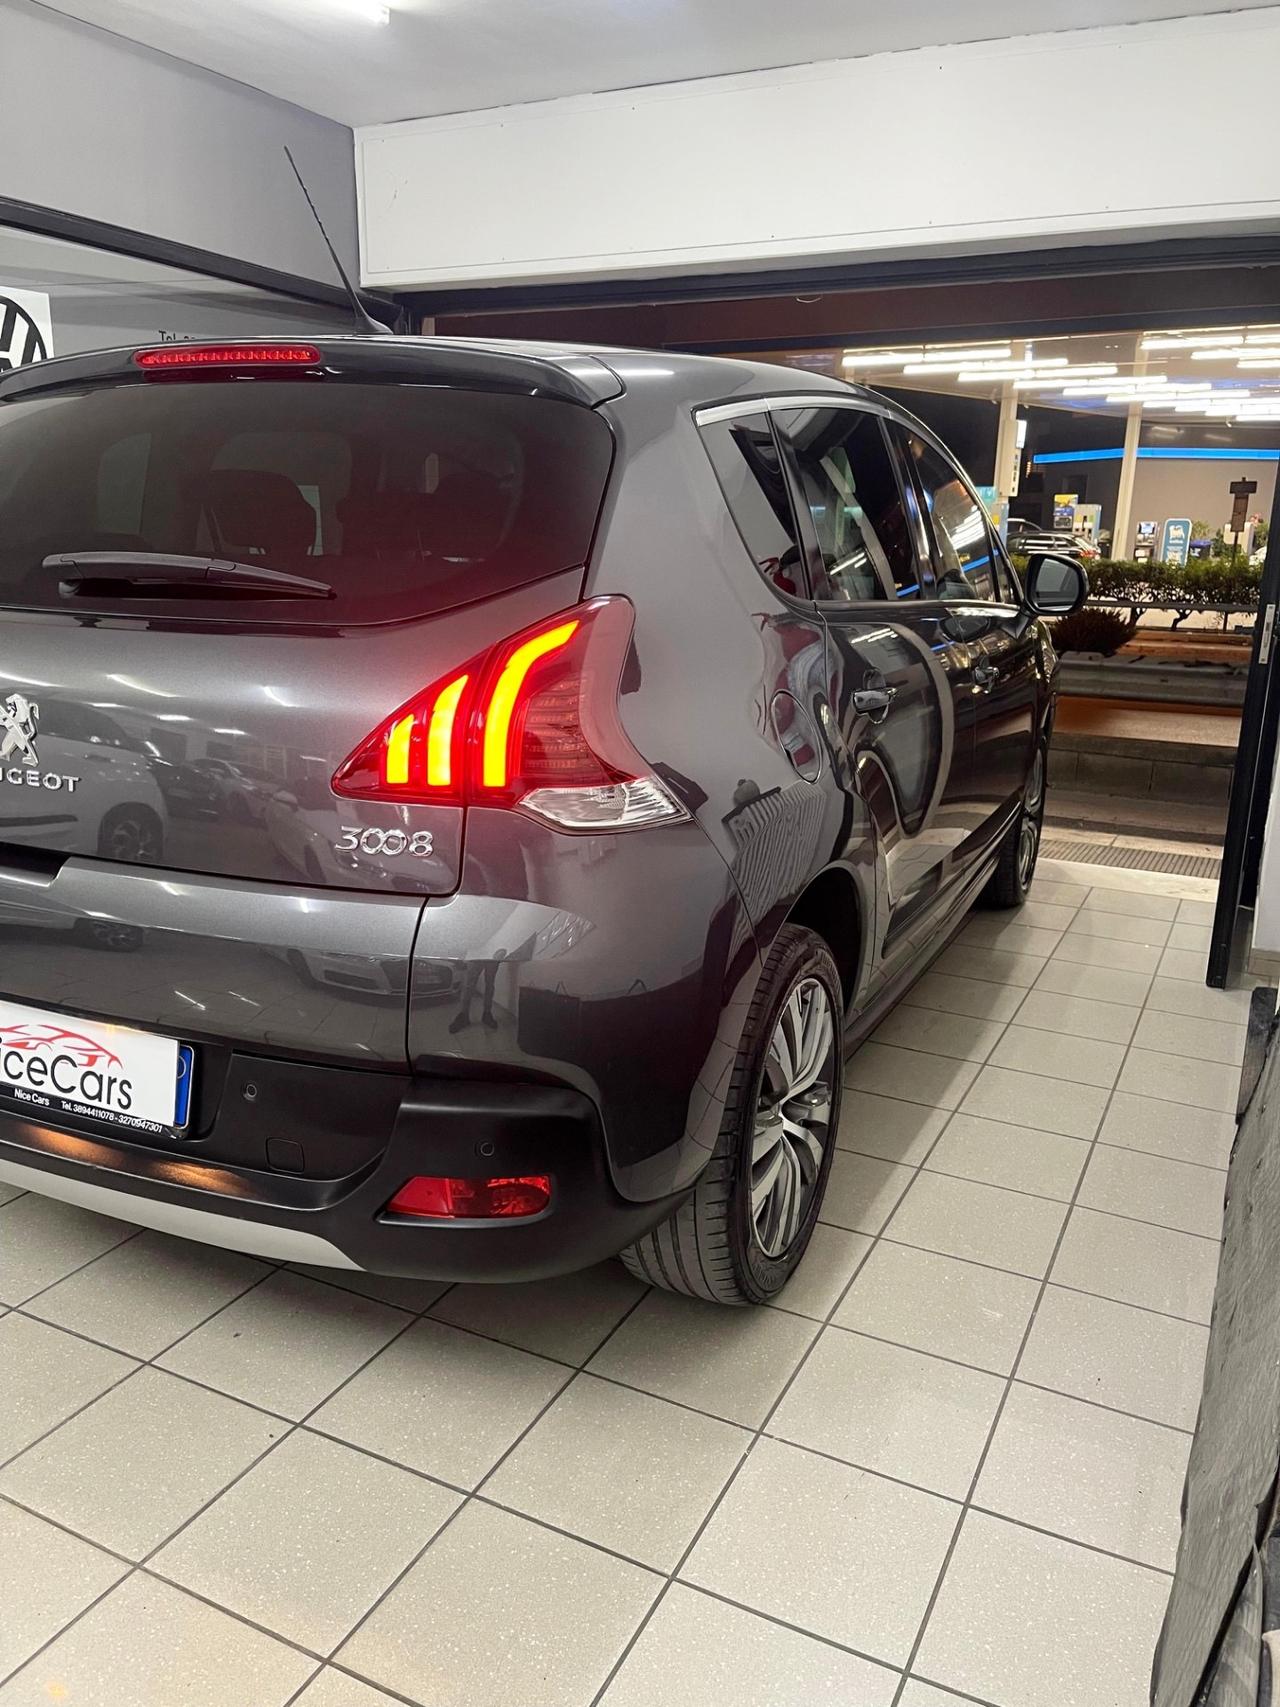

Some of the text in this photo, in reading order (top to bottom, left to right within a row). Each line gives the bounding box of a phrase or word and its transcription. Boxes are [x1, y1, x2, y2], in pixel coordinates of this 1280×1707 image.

[0, 767, 81, 792] GEOT
[334, 825, 434, 857] 3008
[14, 1088, 31, 1101] Nice
[32, 1093, 50, 1106] Cars
[61, 1100, 72, 1110] Tel.
[73, 1103, 115, 1121] 3894411078
